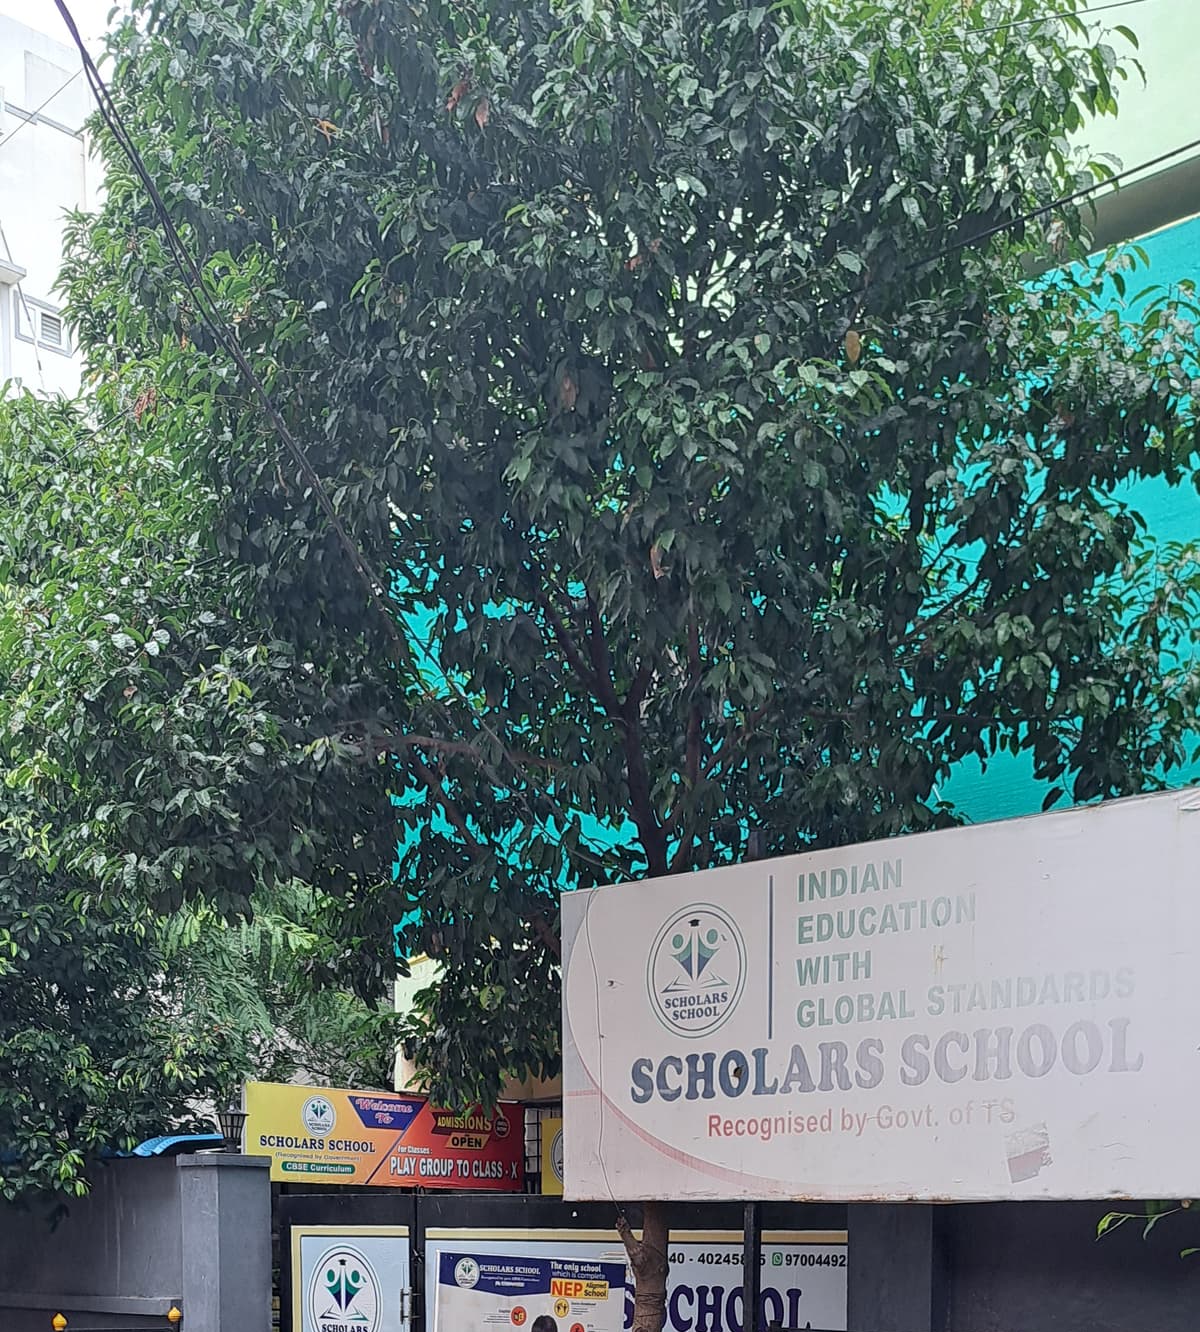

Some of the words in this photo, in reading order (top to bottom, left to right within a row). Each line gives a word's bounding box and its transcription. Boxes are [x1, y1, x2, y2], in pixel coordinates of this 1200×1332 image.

[797, 859, 903, 903] INDIAN
[797, 893, 977, 945] EDUCATION
[797, 950, 871, 986] WITH
[664, 991, 728, 1010] SCHOLARS
[797, 987, 915, 1029] GLOBAL
[927, 967, 1136, 1016] STANDARDS
[672, 1004, 721, 1021] SCHOOL
[630, 1038, 885, 1104] SCHOLARS
[899, 1017, 1144, 1086] SCHOOL
[356, 1098, 413, 1114] Welcome
[375, 1112, 394, 1125] To
[437, 1116, 492, 1131] ADMISSIONS
[708, 1109, 833, 1141] Recognised
[841, 1109, 867, 1136] by
[876, 1105, 940, 1131] Govt.
[949, 1101, 974, 1126] of
[260, 1135, 324, 1150] SCHOLARS
[328, 1139, 376, 1153] SCHOOL
[451, 1136, 482, 1148] OPEN
[286, 1162, 308, 1170] CBSE
[310, 1163, 352, 1173] Curriculum
[390, 1156, 416, 1176] PLAY
[420, 1158, 454, 1177] GROUP
[456, 1159, 470, 1177] TO
[473, 1160, 503, 1178] CLASS
[511, 1161, 518, 1179] X
[668, 1252, 685, 1264] 40
[480, 1264, 514, 1273] SCHOLARS
[514, 1265, 541, 1275] SCHOOL
[550, 1261, 563, 1270] The
[580, 1262, 602, 1273] school
[552, 1270, 571, 1278] which
[551, 1281, 583, 1297] NEP
[586, 1281, 607, 1290] Aligned
[584, 1288, 607, 1297] School
